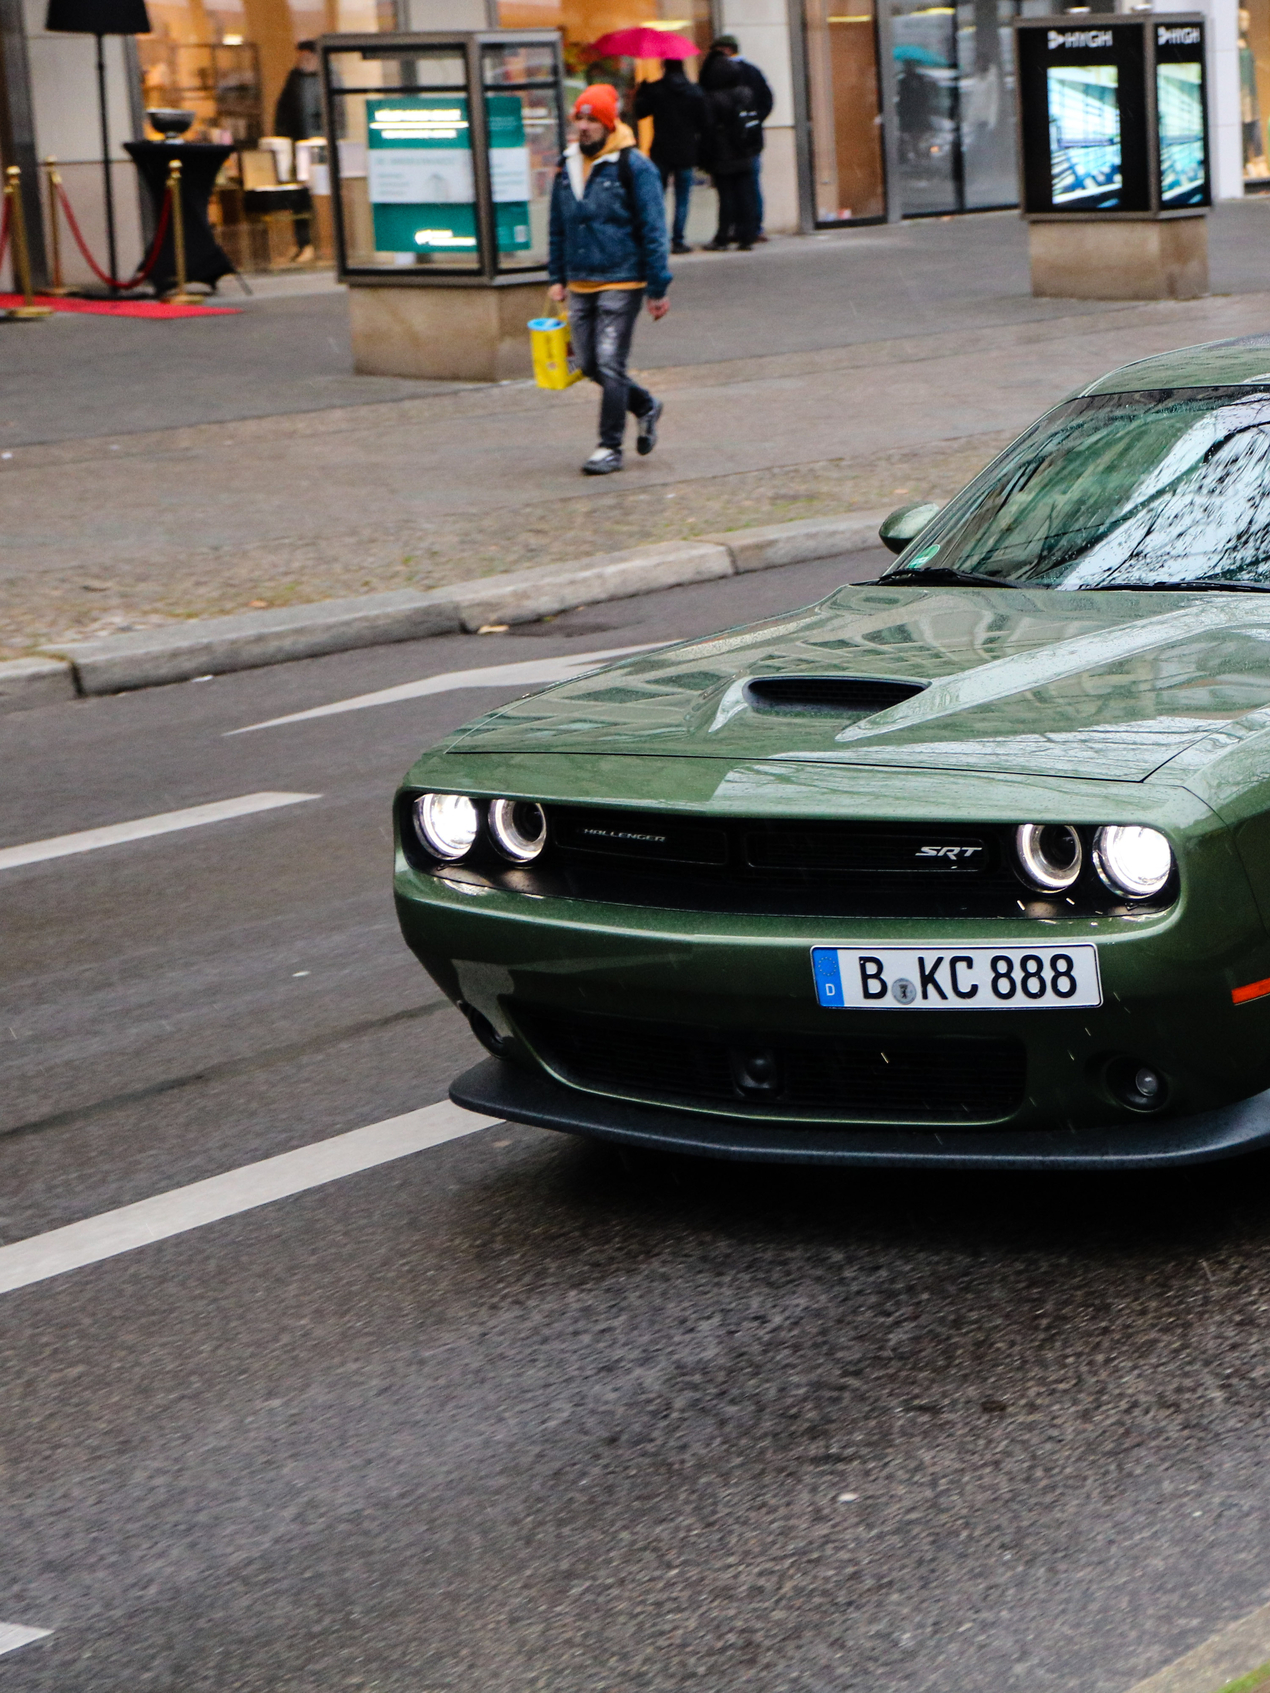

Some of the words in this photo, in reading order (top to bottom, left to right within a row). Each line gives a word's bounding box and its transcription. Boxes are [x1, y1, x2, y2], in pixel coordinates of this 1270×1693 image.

[579, 828, 666, 842] HALLENGER
[915, 846, 983, 860] SRT
[858, 956, 889, 1000] B
[917, 955, 979, 1000] KC
[990, 953, 1078, 1000] 888
[825, 983, 836, 997] D
